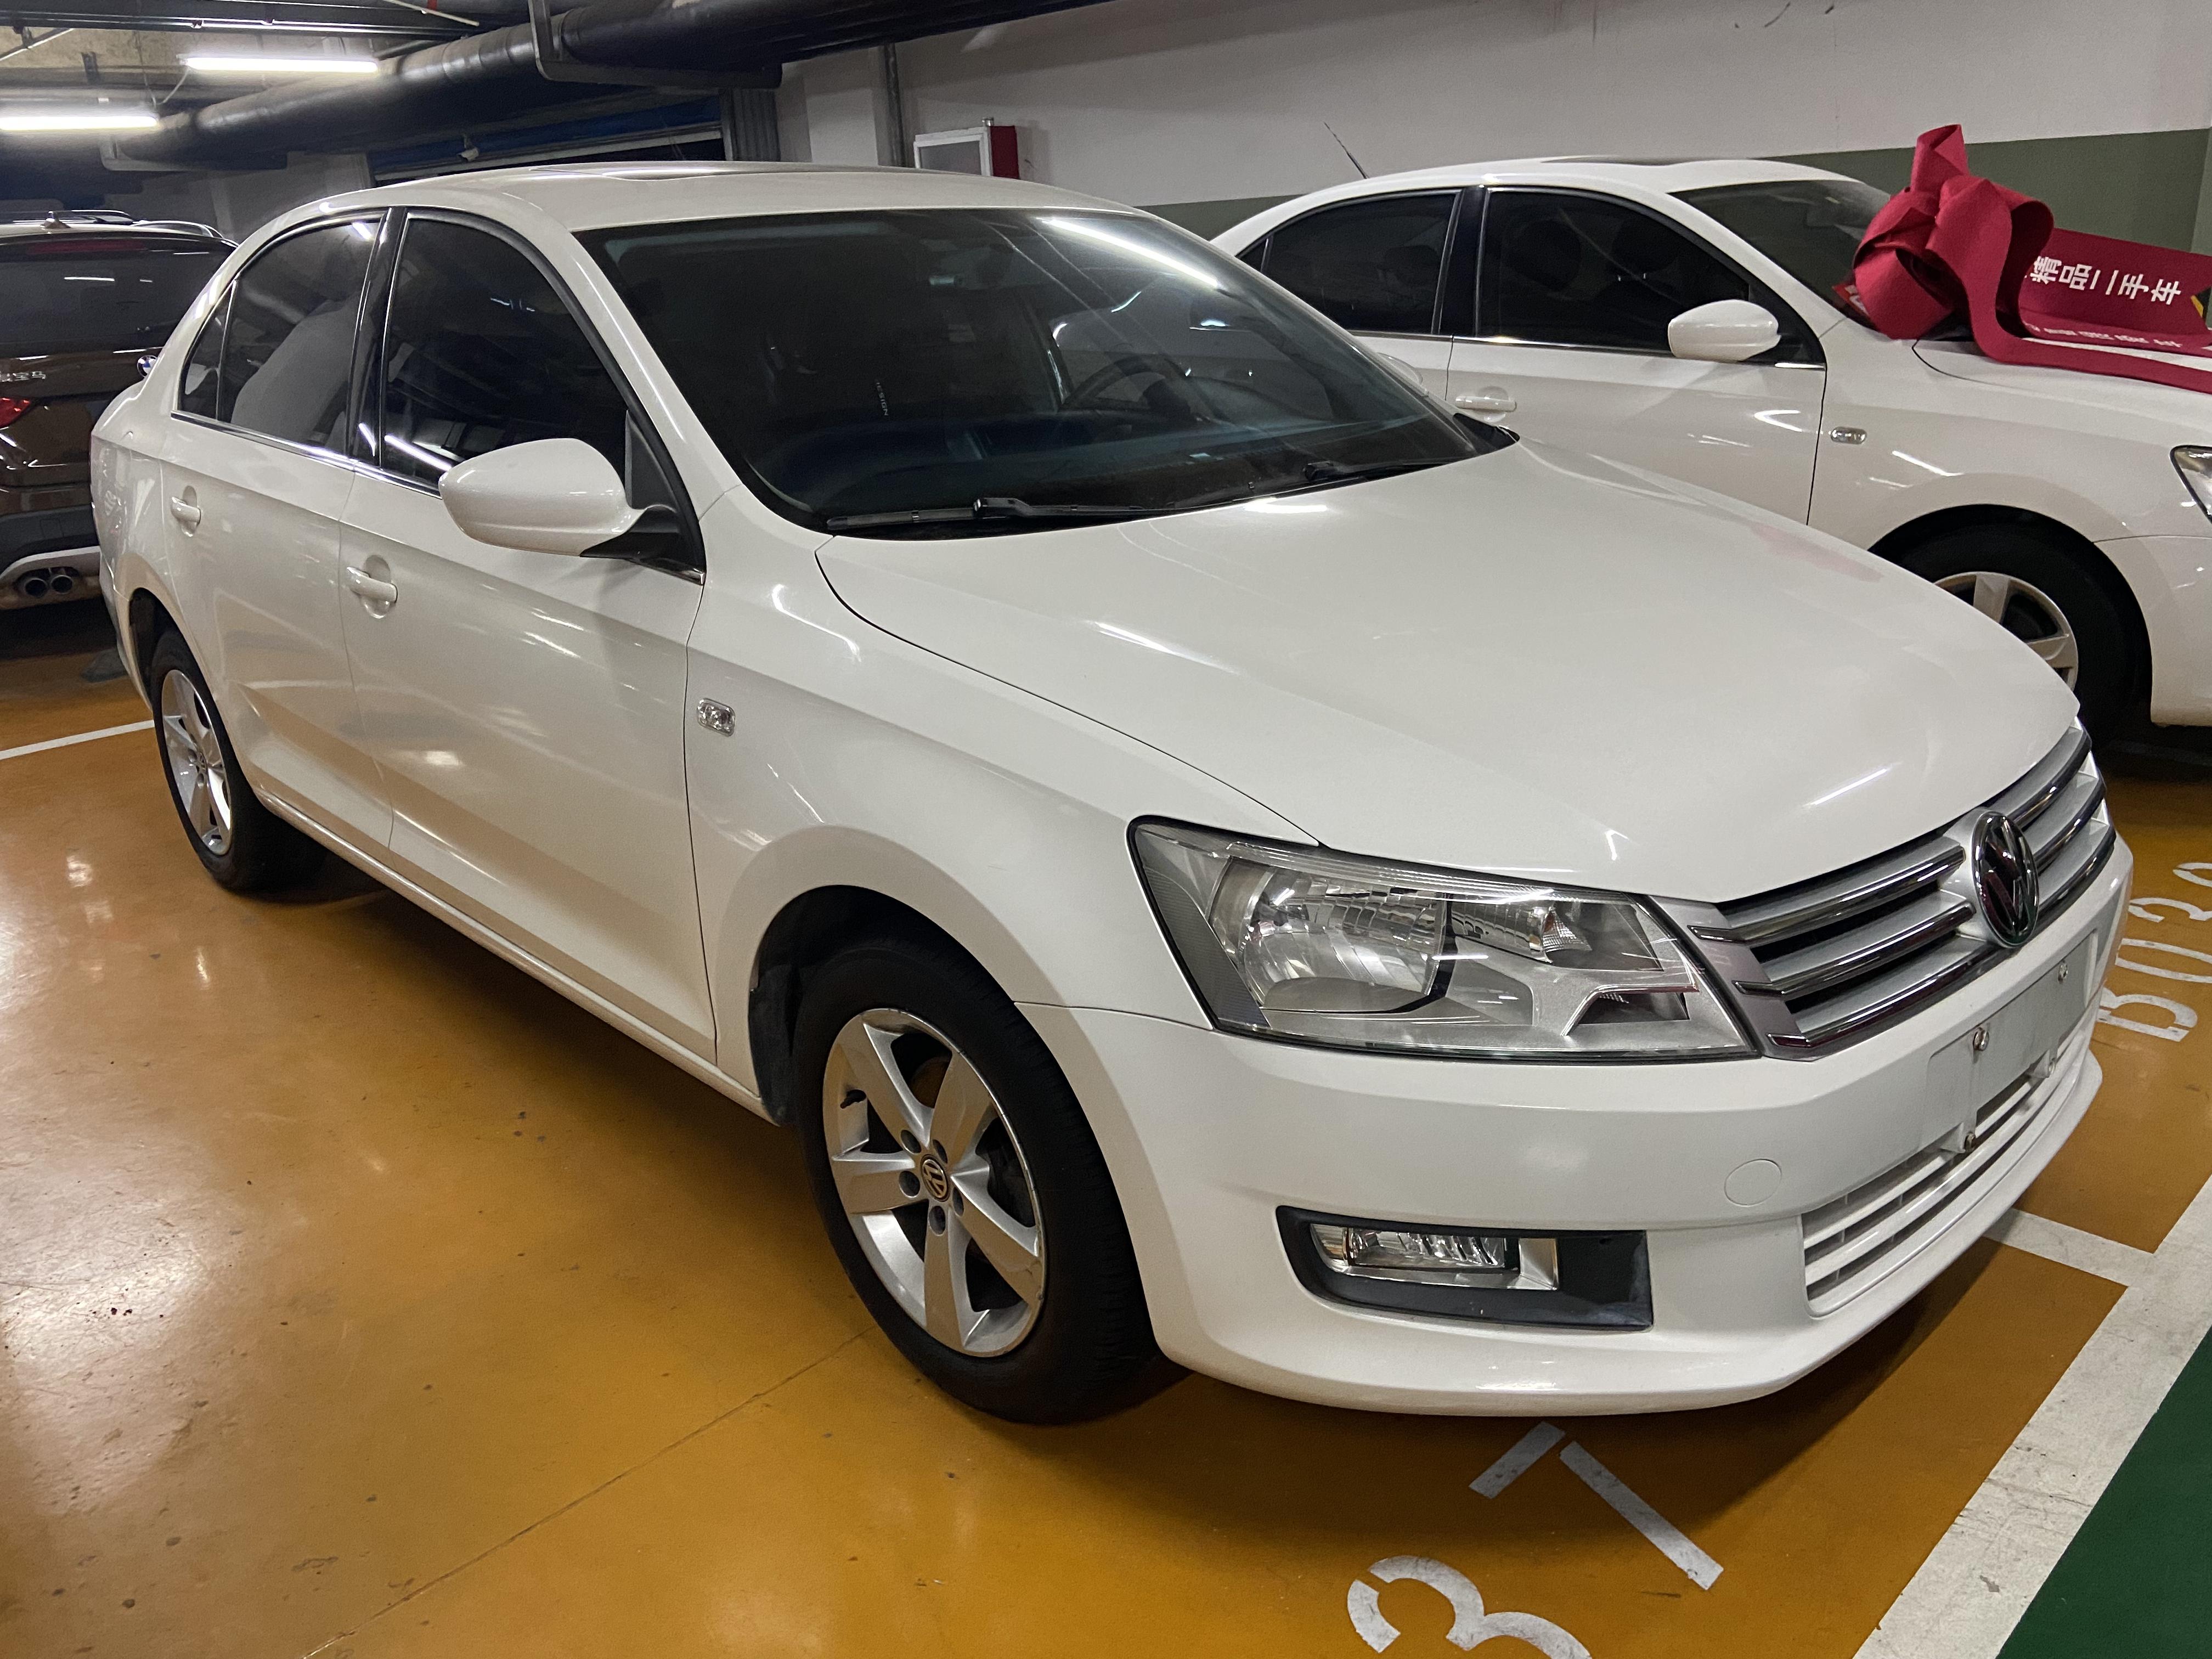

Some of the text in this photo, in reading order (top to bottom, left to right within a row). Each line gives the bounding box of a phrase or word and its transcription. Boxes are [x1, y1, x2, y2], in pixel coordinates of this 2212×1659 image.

[2030, 256, 2181, 305] 精品二手车
